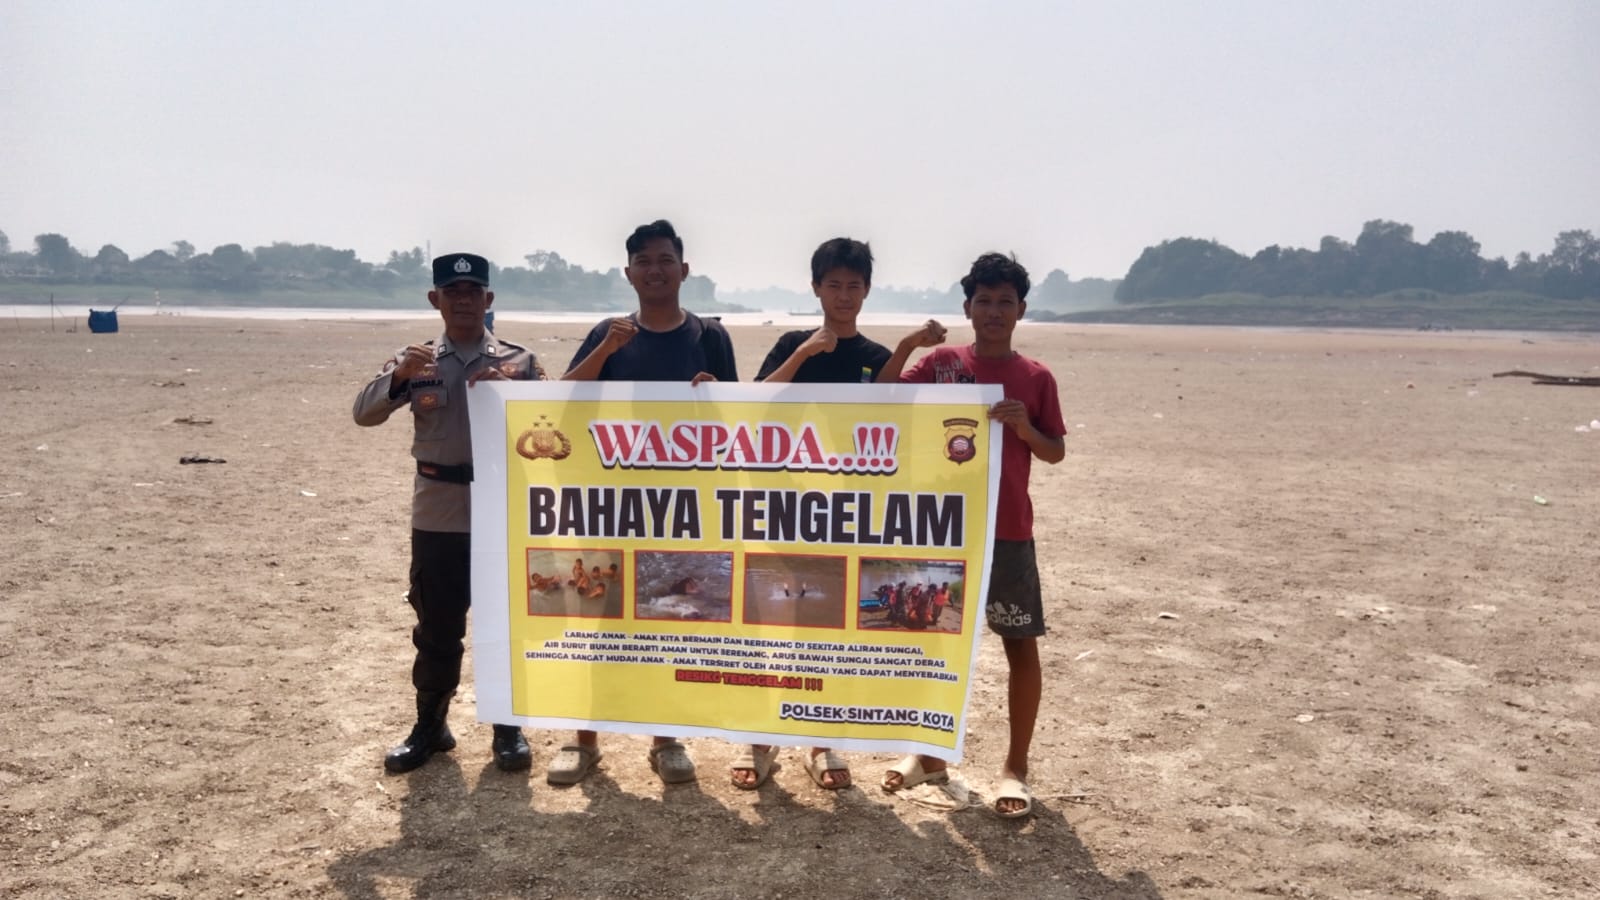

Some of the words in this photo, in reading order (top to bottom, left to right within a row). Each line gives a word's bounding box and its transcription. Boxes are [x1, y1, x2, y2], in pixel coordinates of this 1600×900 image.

[530, 487, 701, 539] BAHAYA
[717, 489, 964, 547] TENGELAM
[565, 631, 599, 639] LARANG
[682, 636, 722, 644] BERMAIN
[724, 637, 742, 645] DAN
[744, 639, 793, 649] BERENANG
[807, 643, 845, 651] SEKITAR
[848, 644, 882, 653] ALIRAN
[885, 646, 923, 656] SUNGAI,
[526, 651, 569, 660] SEHINGGA
[571, 653, 604, 661] SANGAT
[606, 655, 638, 663] MUDAH
[640, 656, 664, 664] ANAK
[743, 662, 766, 670] OLEH
[795, 665, 829, 674] SUNGAI
[832, 667, 857, 675] YANG
[860, 669, 893, 677] DAPAT
[894, 670, 958, 682] MENYEBABKAN
[690, 647, 718, 655] UNTUK
[721, 648, 769, 659] BERENANG,
[799, 654, 834, 662] BAWAH
[836, 655, 871, 664] SUNGAI
[874, 657, 912, 666] SANGAT
[915, 659, 945, 668] DERAS
[676, 669, 721, 683] RESIKO
[722, 672, 802, 689] TENGGELAM
[805, 678, 823, 691] !!!
[781, 703, 844, 719] POLSEK
[848, 707, 918, 722] SINTANG
[923, 711, 954, 728] KOTA
